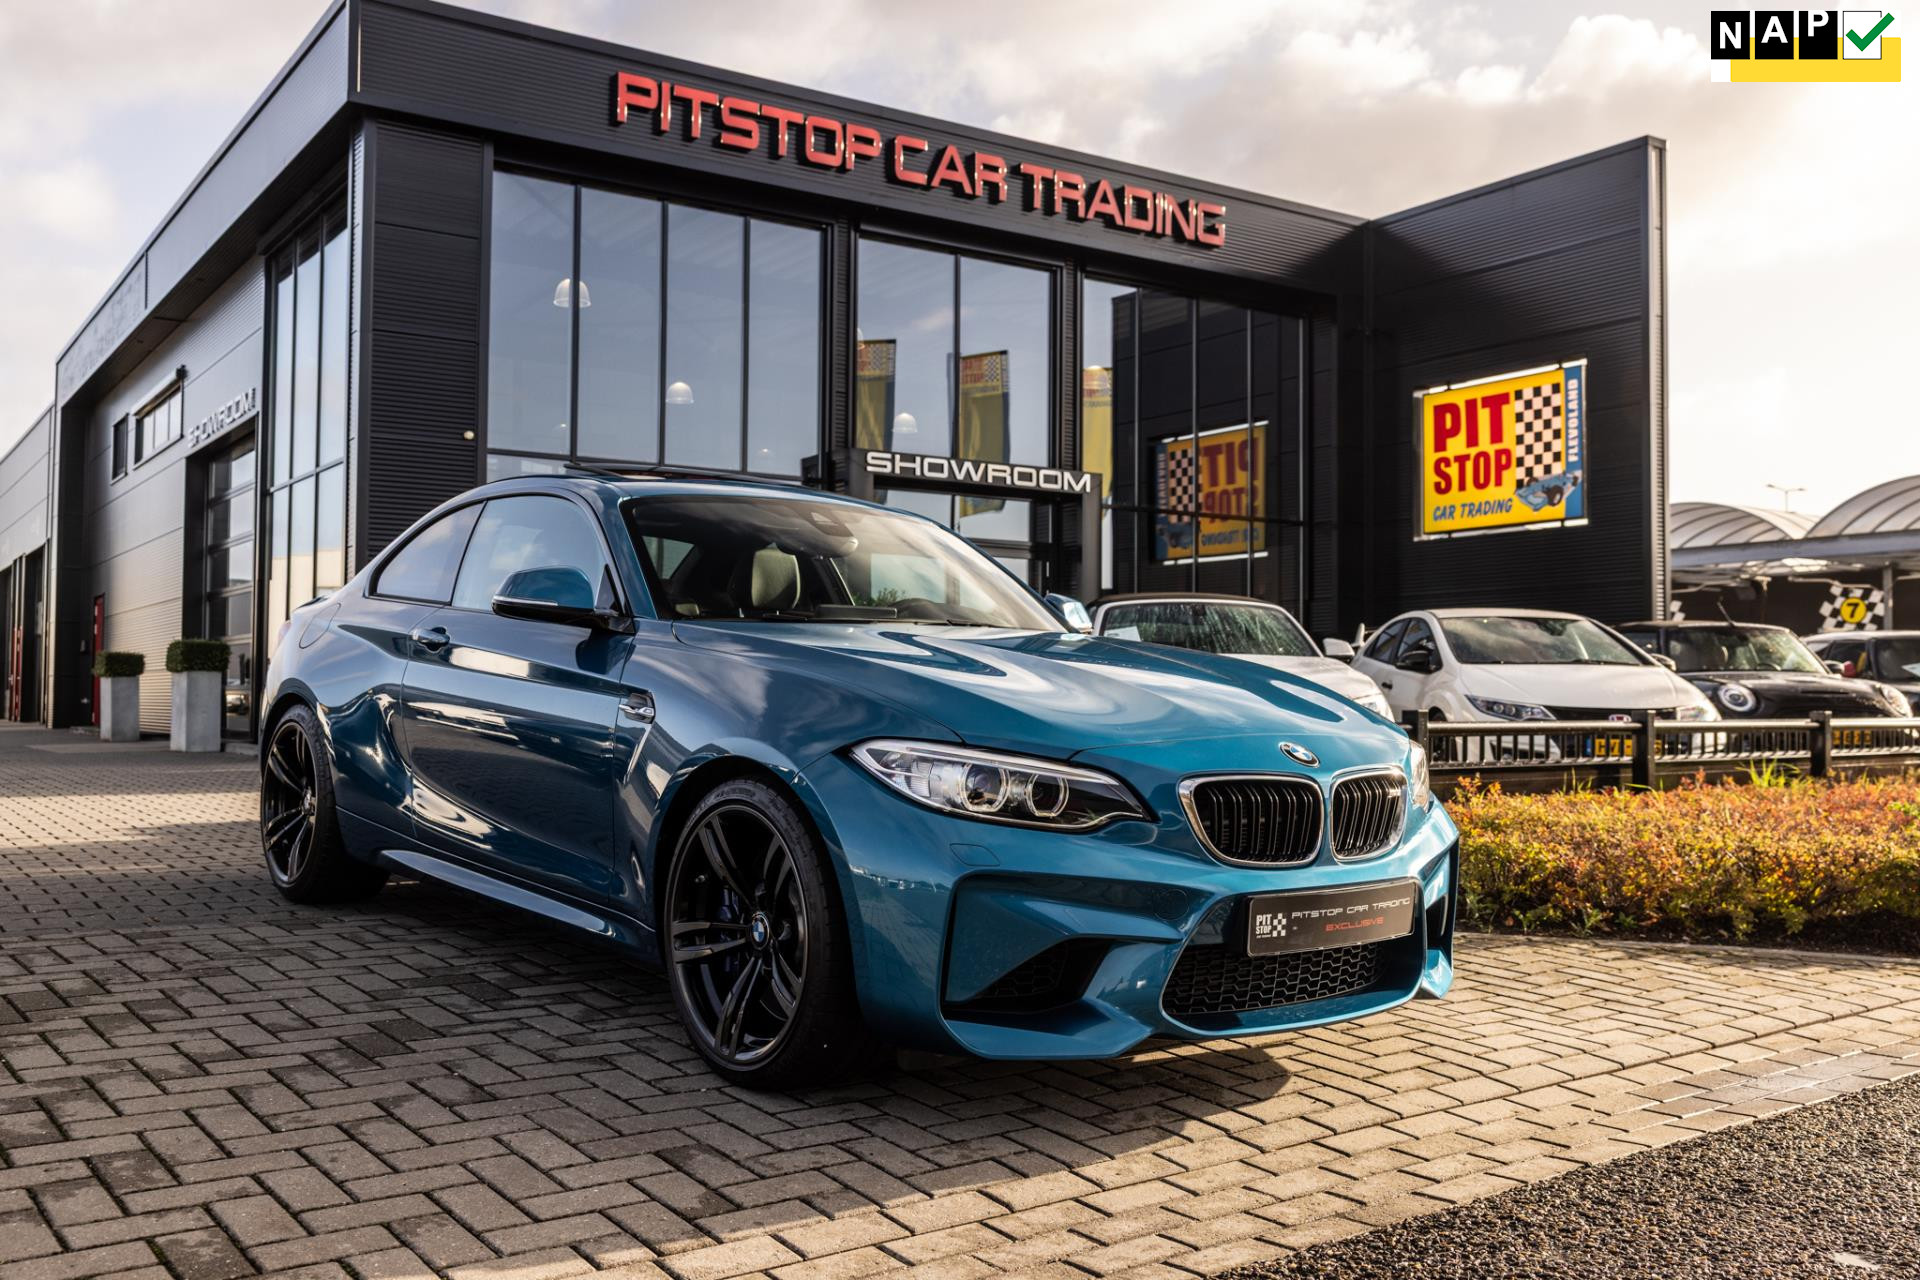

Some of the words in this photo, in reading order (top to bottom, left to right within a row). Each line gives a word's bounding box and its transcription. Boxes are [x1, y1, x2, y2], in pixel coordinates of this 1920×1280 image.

[615, 71, 883, 172] PITSTOP
[894, 135, 1008, 203] CAR
[1020, 162, 1227, 247] TRADING
[1433, 392, 1510, 453] PIT
[1567, 378, 1579, 462] FLEVOLAND
[866, 451, 1091, 493] SHOWROOM
[1433, 448, 1512, 495] STOP
[1433, 505, 1456, 522] CAR
[1460, 497, 1513, 519] TRADING
[1846, 602, 1861, 619] 7
[1256, 913, 1272, 926] PIT
[1291, 907, 1344, 920] PITSTOP
[1346, 903, 1369, 914] CAR
[1325, 916, 1385, 932] EXCLUSIVE
[1255, 925, 1272, 934] STOP
